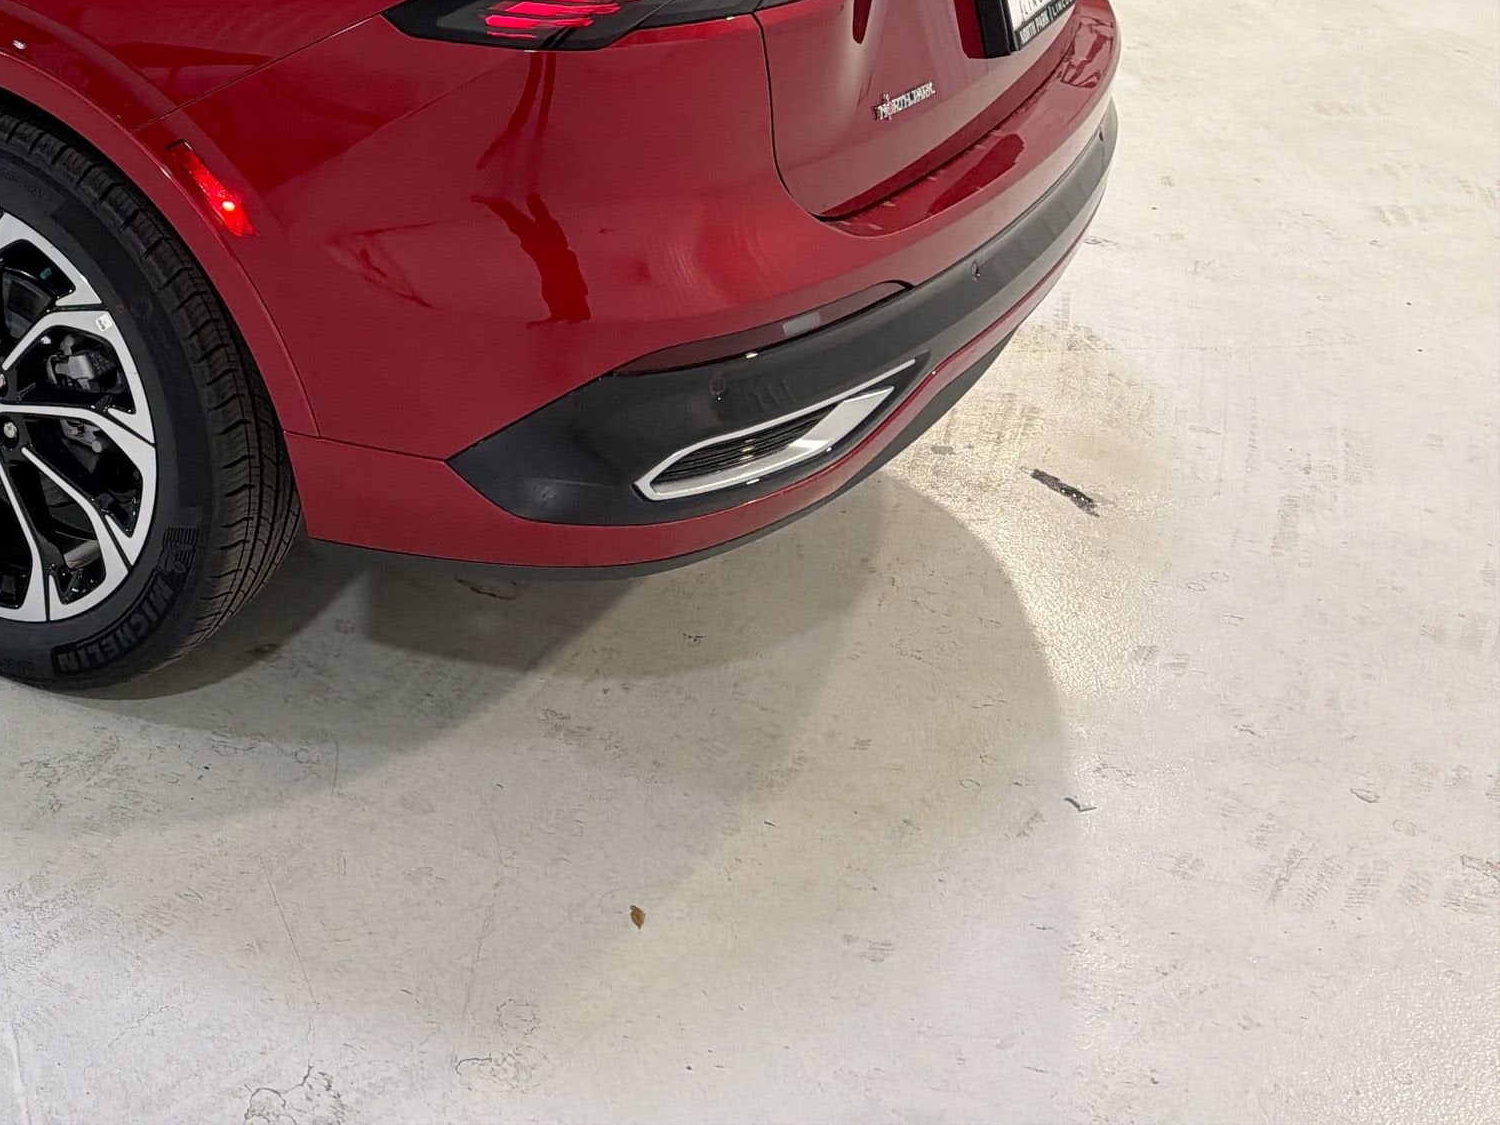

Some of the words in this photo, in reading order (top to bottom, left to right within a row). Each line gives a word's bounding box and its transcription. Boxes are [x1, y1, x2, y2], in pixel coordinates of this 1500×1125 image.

[878, 91, 911, 120] NORTH
[911, 81, 936, 105] PARK
[55, 572, 175, 672] MICHELIN
